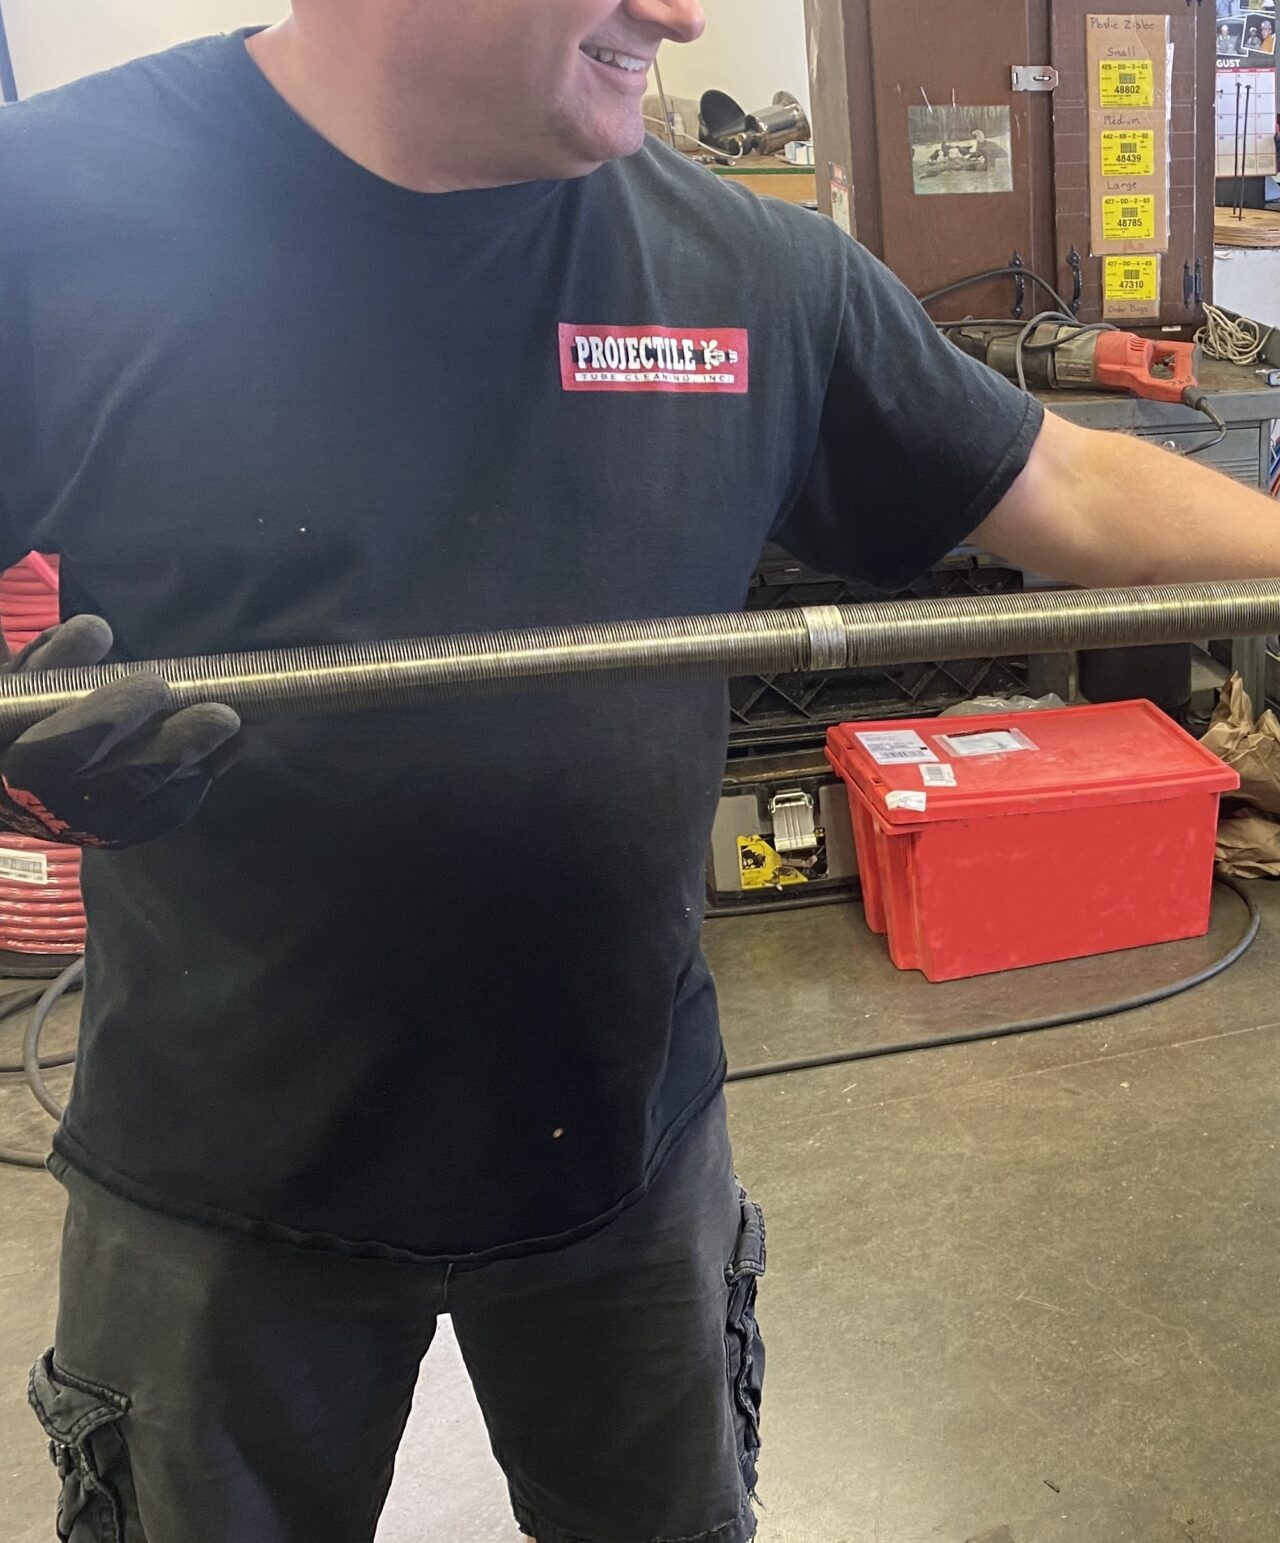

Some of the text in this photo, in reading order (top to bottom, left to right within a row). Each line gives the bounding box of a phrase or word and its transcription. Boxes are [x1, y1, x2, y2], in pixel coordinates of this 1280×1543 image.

[1107, 47, 1135, 56] Small
[1216, 59, 1241, 68] GUST
[1114, 85, 1141, 94] 48802
[1116, 154, 1142, 162] 48439
[1106, 181, 1137, 191] Large
[1117, 218, 1143, 227] 48785
[1119, 280, 1144, 289] 47310
[575, 335, 696, 371] PROJECTILE
